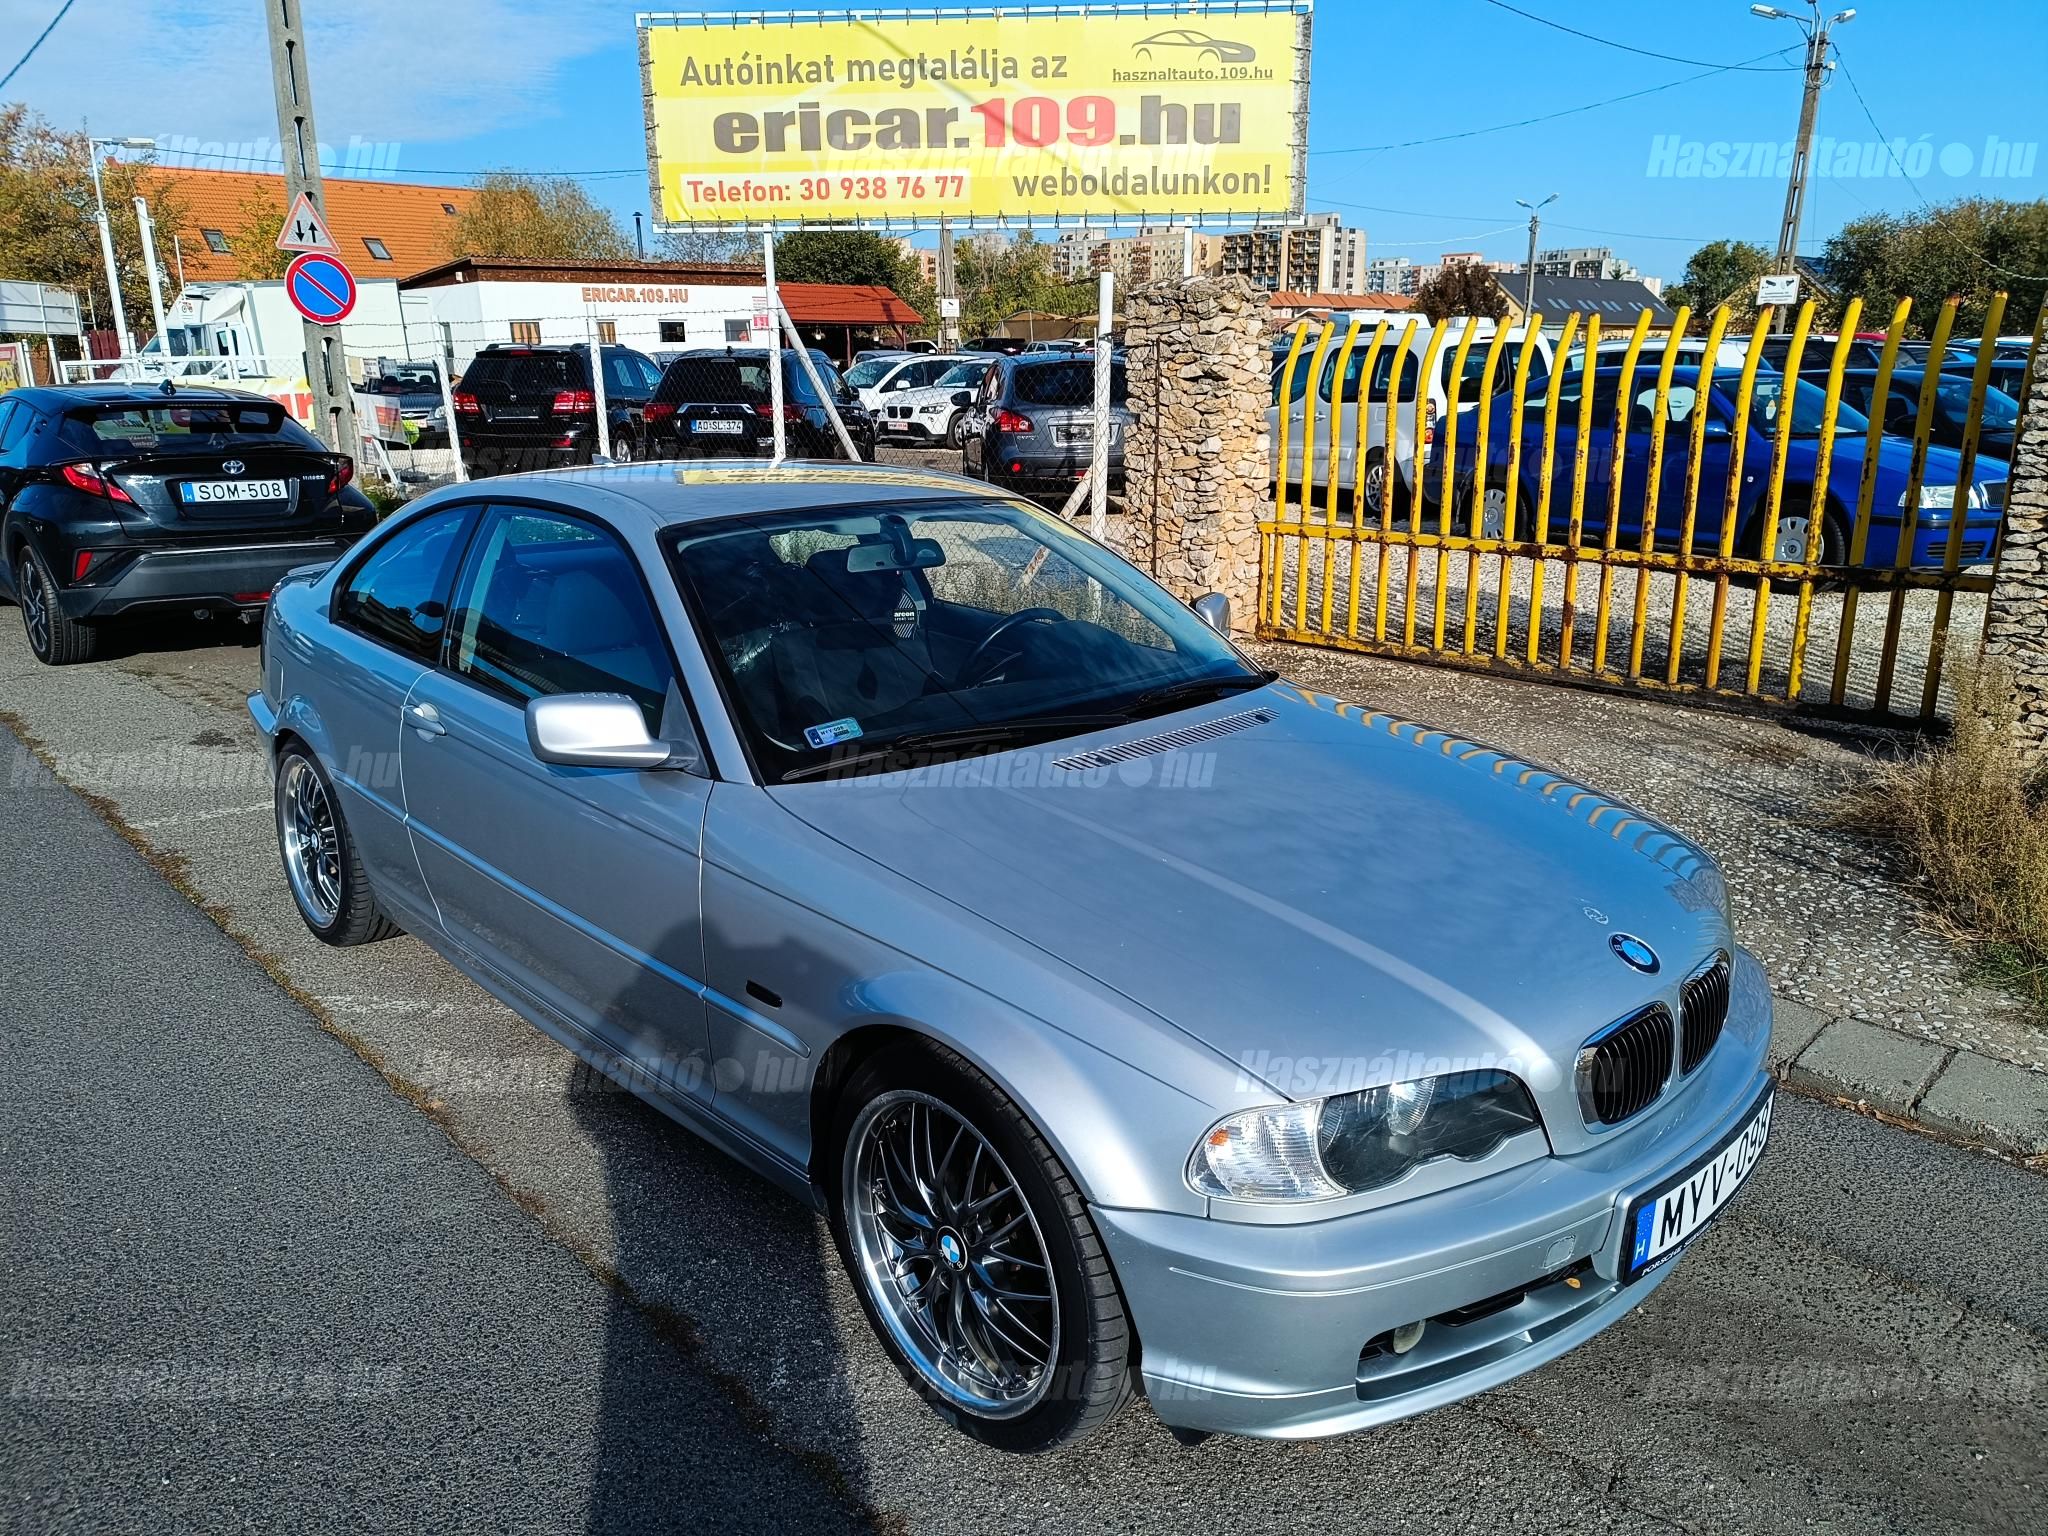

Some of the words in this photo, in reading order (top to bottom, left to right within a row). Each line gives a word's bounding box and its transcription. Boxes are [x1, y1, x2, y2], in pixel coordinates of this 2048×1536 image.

[681, 51, 834, 86] Autóinkat
[847, 45, 1018, 88] megtalálja
[1032, 55, 1067, 78] az
[1112, 66, 1273, 82] hasznaltauto.109.hu
[713, 95, 1240, 153] ericar.109.hu
[687, 180, 790, 203] Telefon:
[800, 178, 830, 201] 30
[840, 177, 887, 200] 938
[897, 176, 925, 199] 76
[935, 175, 964, 198] 77
[1012, 164, 1271, 197] weboldalunkon!
[581, 287, 689, 303] ERICAR.109.HU
[199, 481, 282, 499] SOM-508
[1634, 1239, 1646, 1260] H
[1658, 1102, 1769, 1248] MYV-098
[1641, 1245, 1683, 1277] PORSCHE
